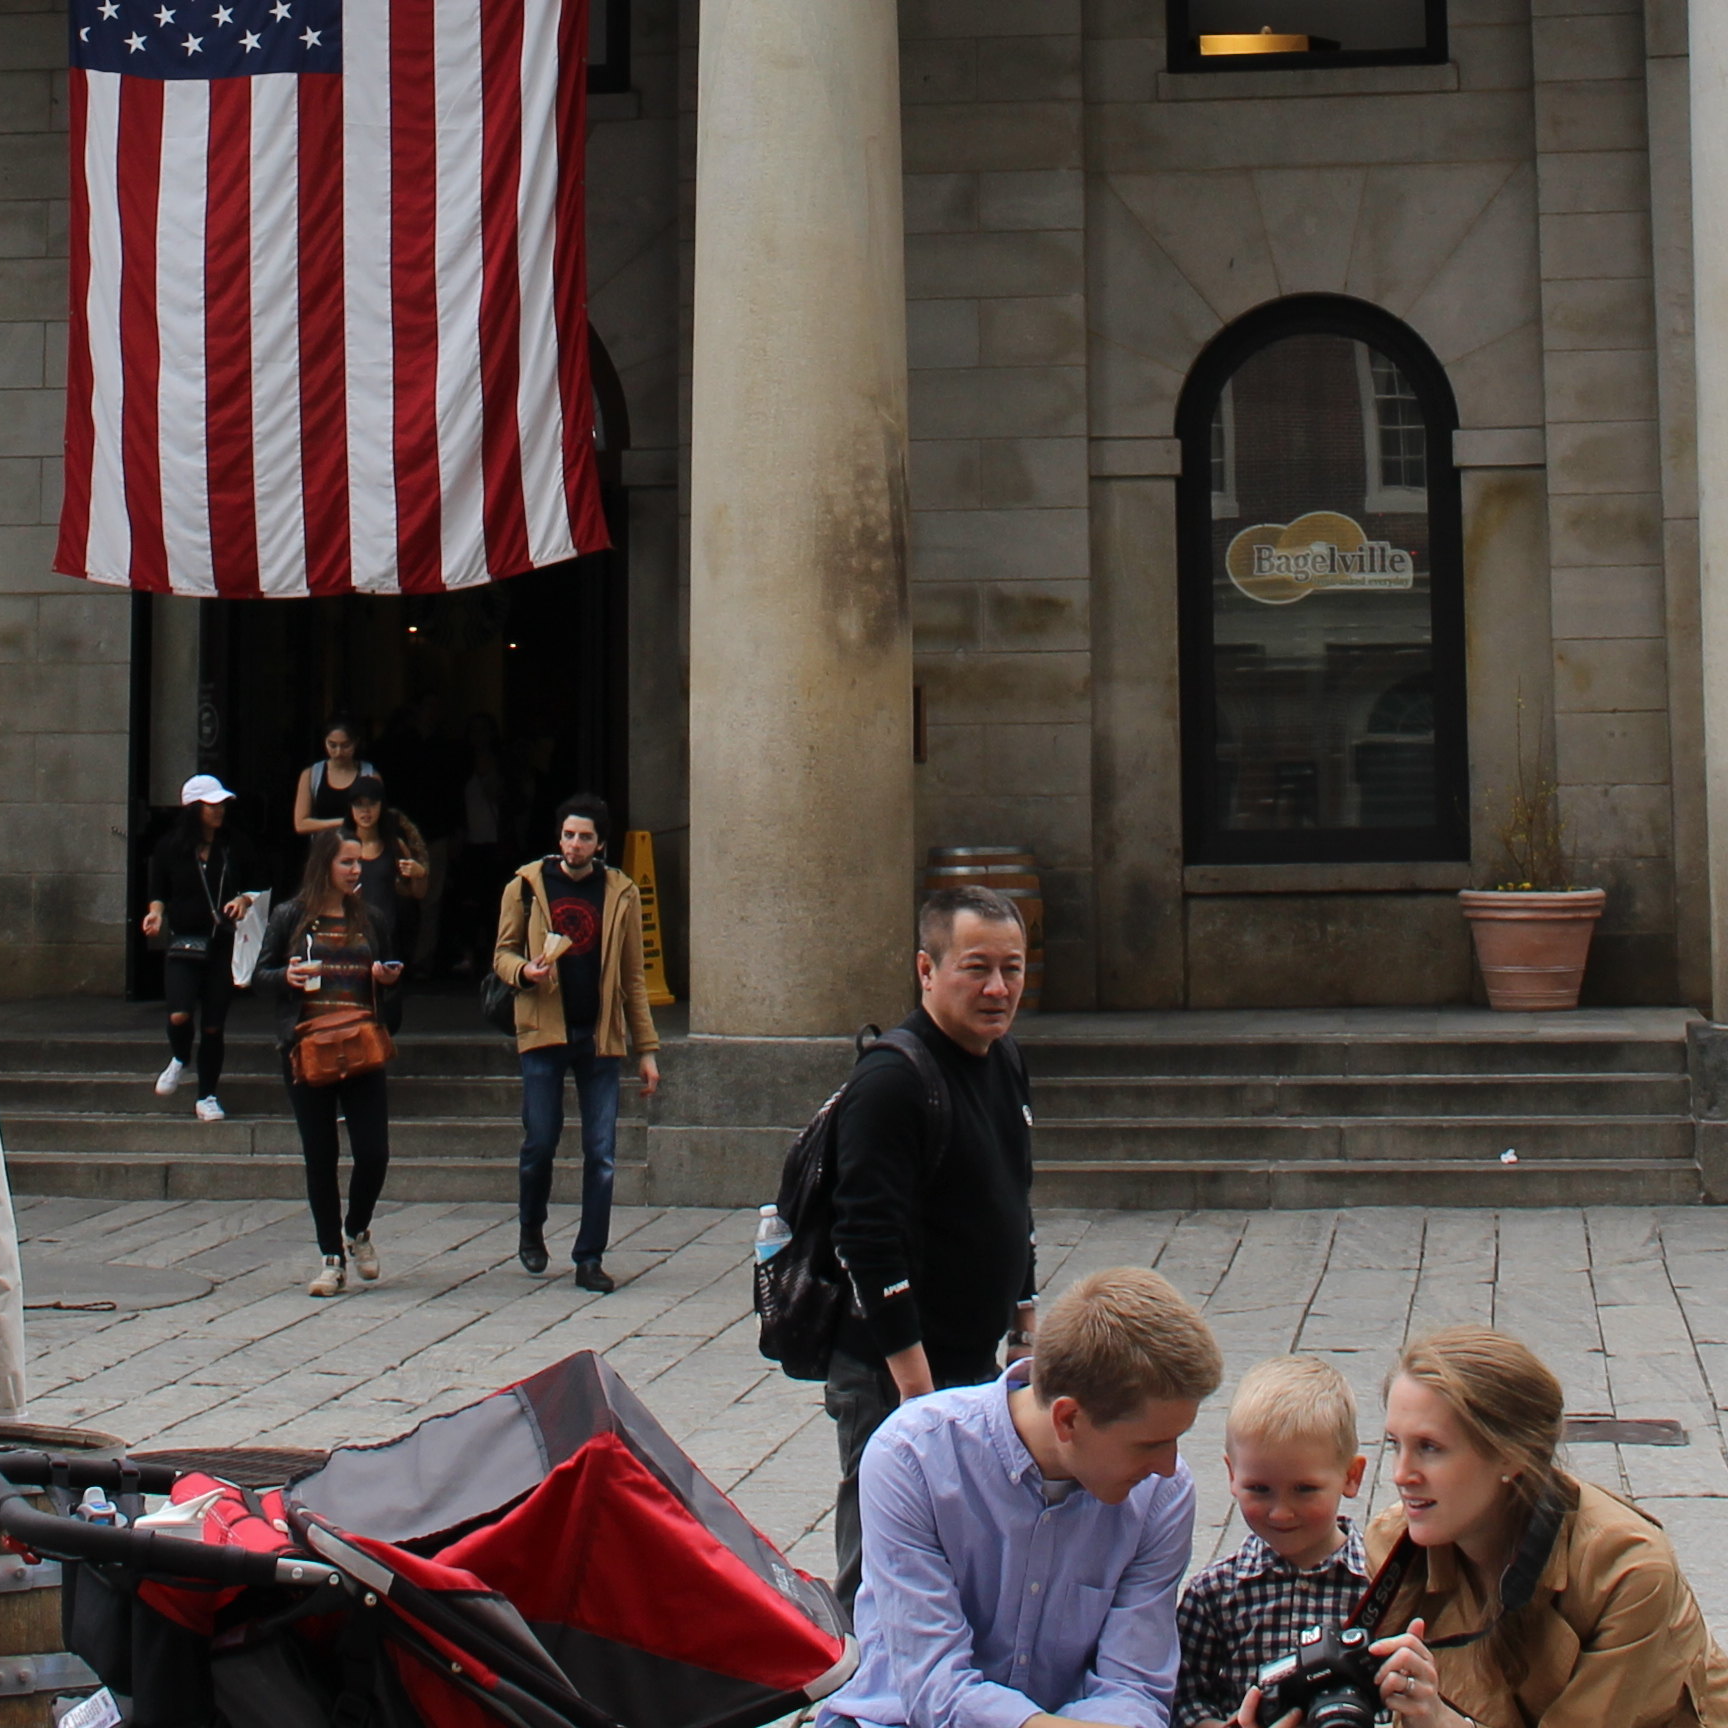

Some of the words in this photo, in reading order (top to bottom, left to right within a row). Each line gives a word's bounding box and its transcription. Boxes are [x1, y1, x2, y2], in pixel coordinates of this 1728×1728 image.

[1254, 544, 1408, 582] Bagelville
[1375, 1561, 1401, 1604] EOS
[1306, 1668, 1332, 1681] Canon
